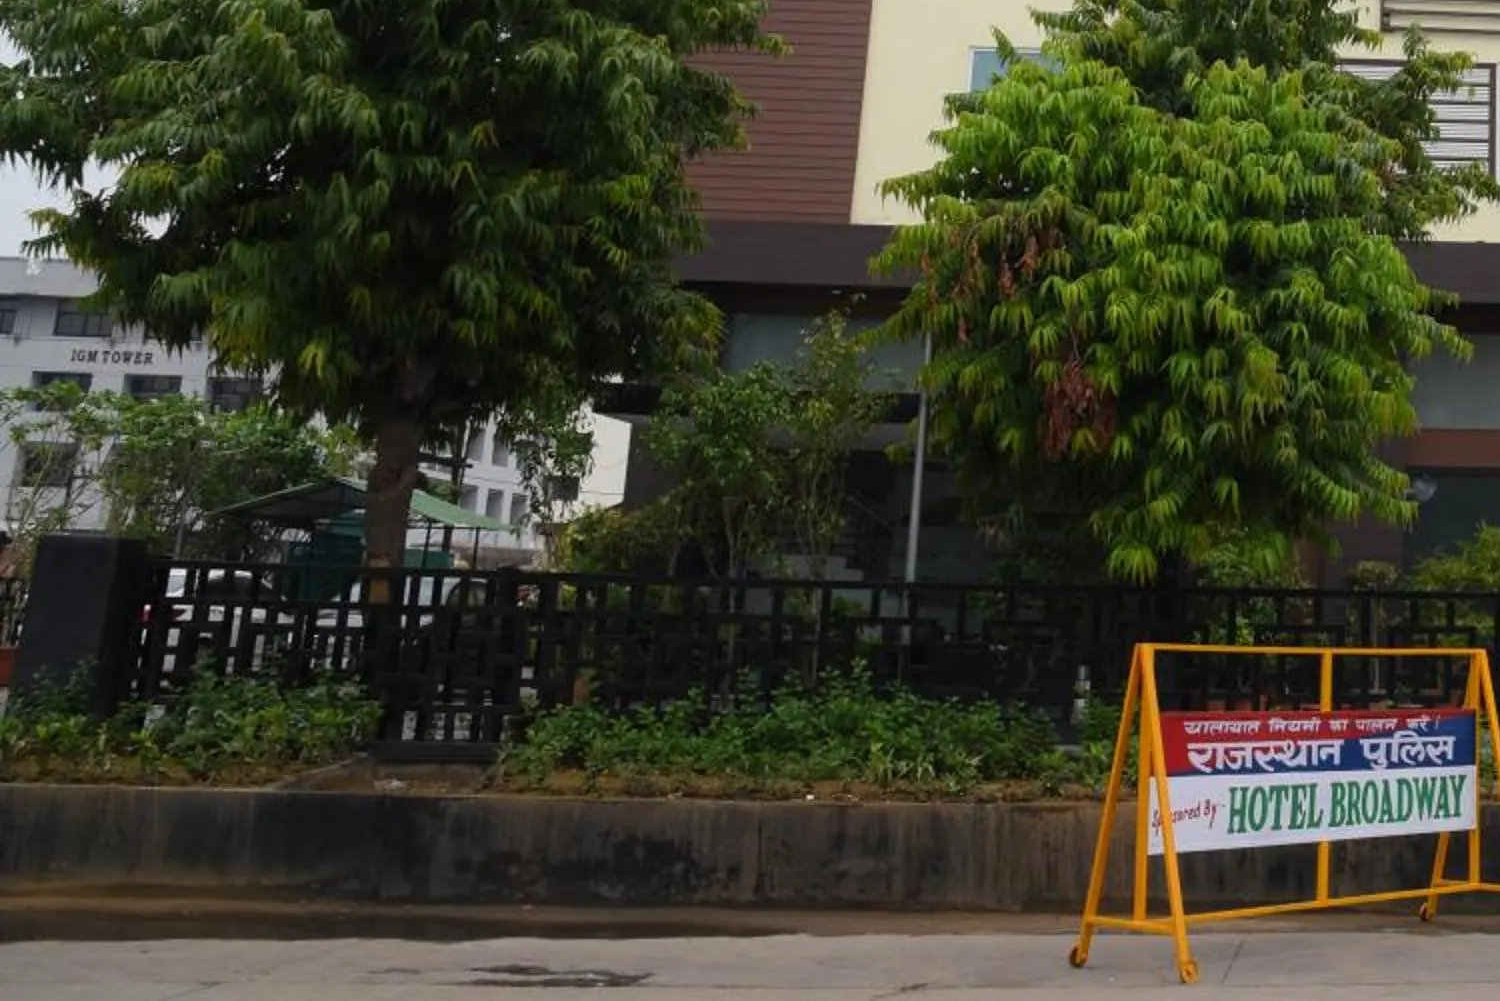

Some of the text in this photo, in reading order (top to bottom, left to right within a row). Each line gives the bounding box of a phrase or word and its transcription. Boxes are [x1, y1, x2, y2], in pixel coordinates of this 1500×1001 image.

[101, 349, 154, 366] TOWER
[1328, 718, 1349, 732] का
[1355, 718, 1399, 733] पालन
[1186, 730, 1457, 773] राजस्थान पुलिस
[1227, 782, 1324, 834] HOTEL
[1328, 774, 1468, 828] BROADWAY
